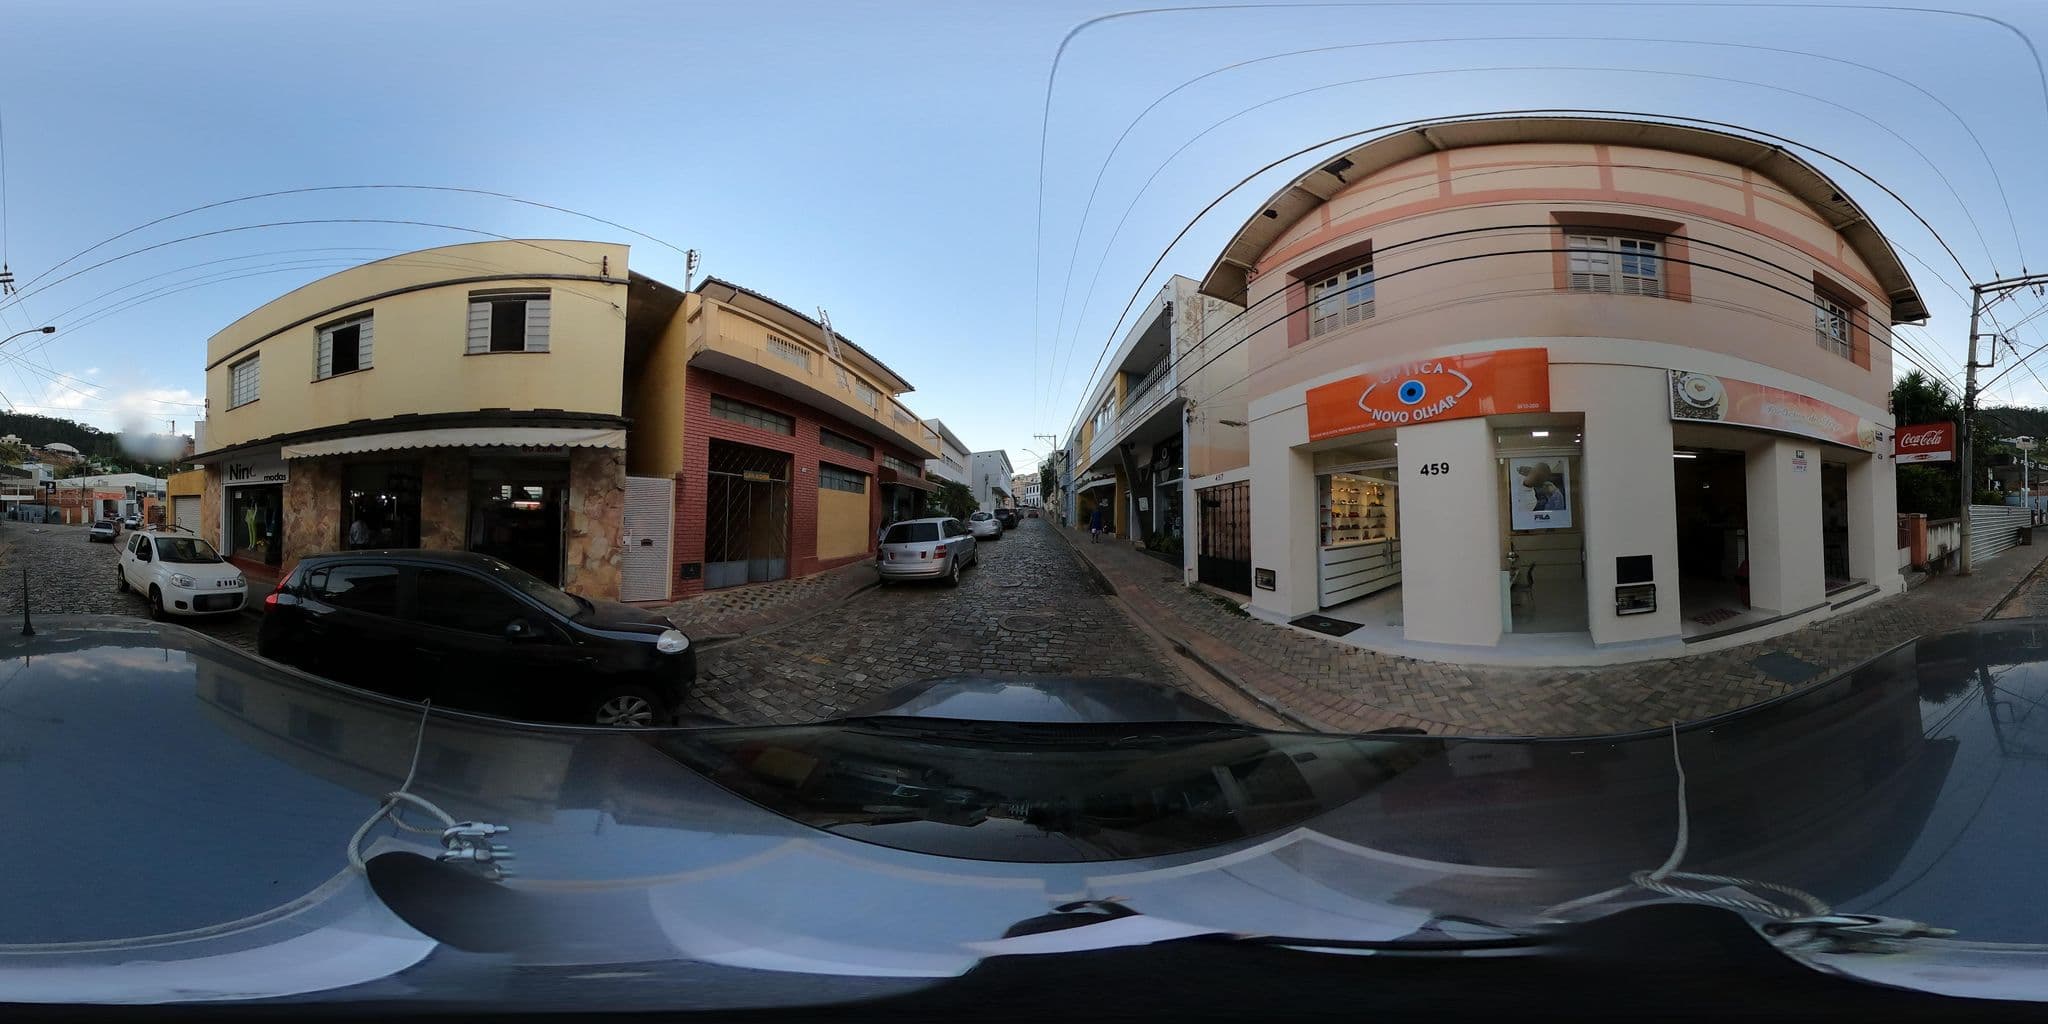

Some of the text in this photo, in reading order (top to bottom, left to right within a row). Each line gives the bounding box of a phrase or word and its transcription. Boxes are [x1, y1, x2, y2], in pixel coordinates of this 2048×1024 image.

[1372, 395, 1458, 423] NOVO OLHAR
[1420, 462, 1450, 476] 459
[264, 473, 286, 481] modas
